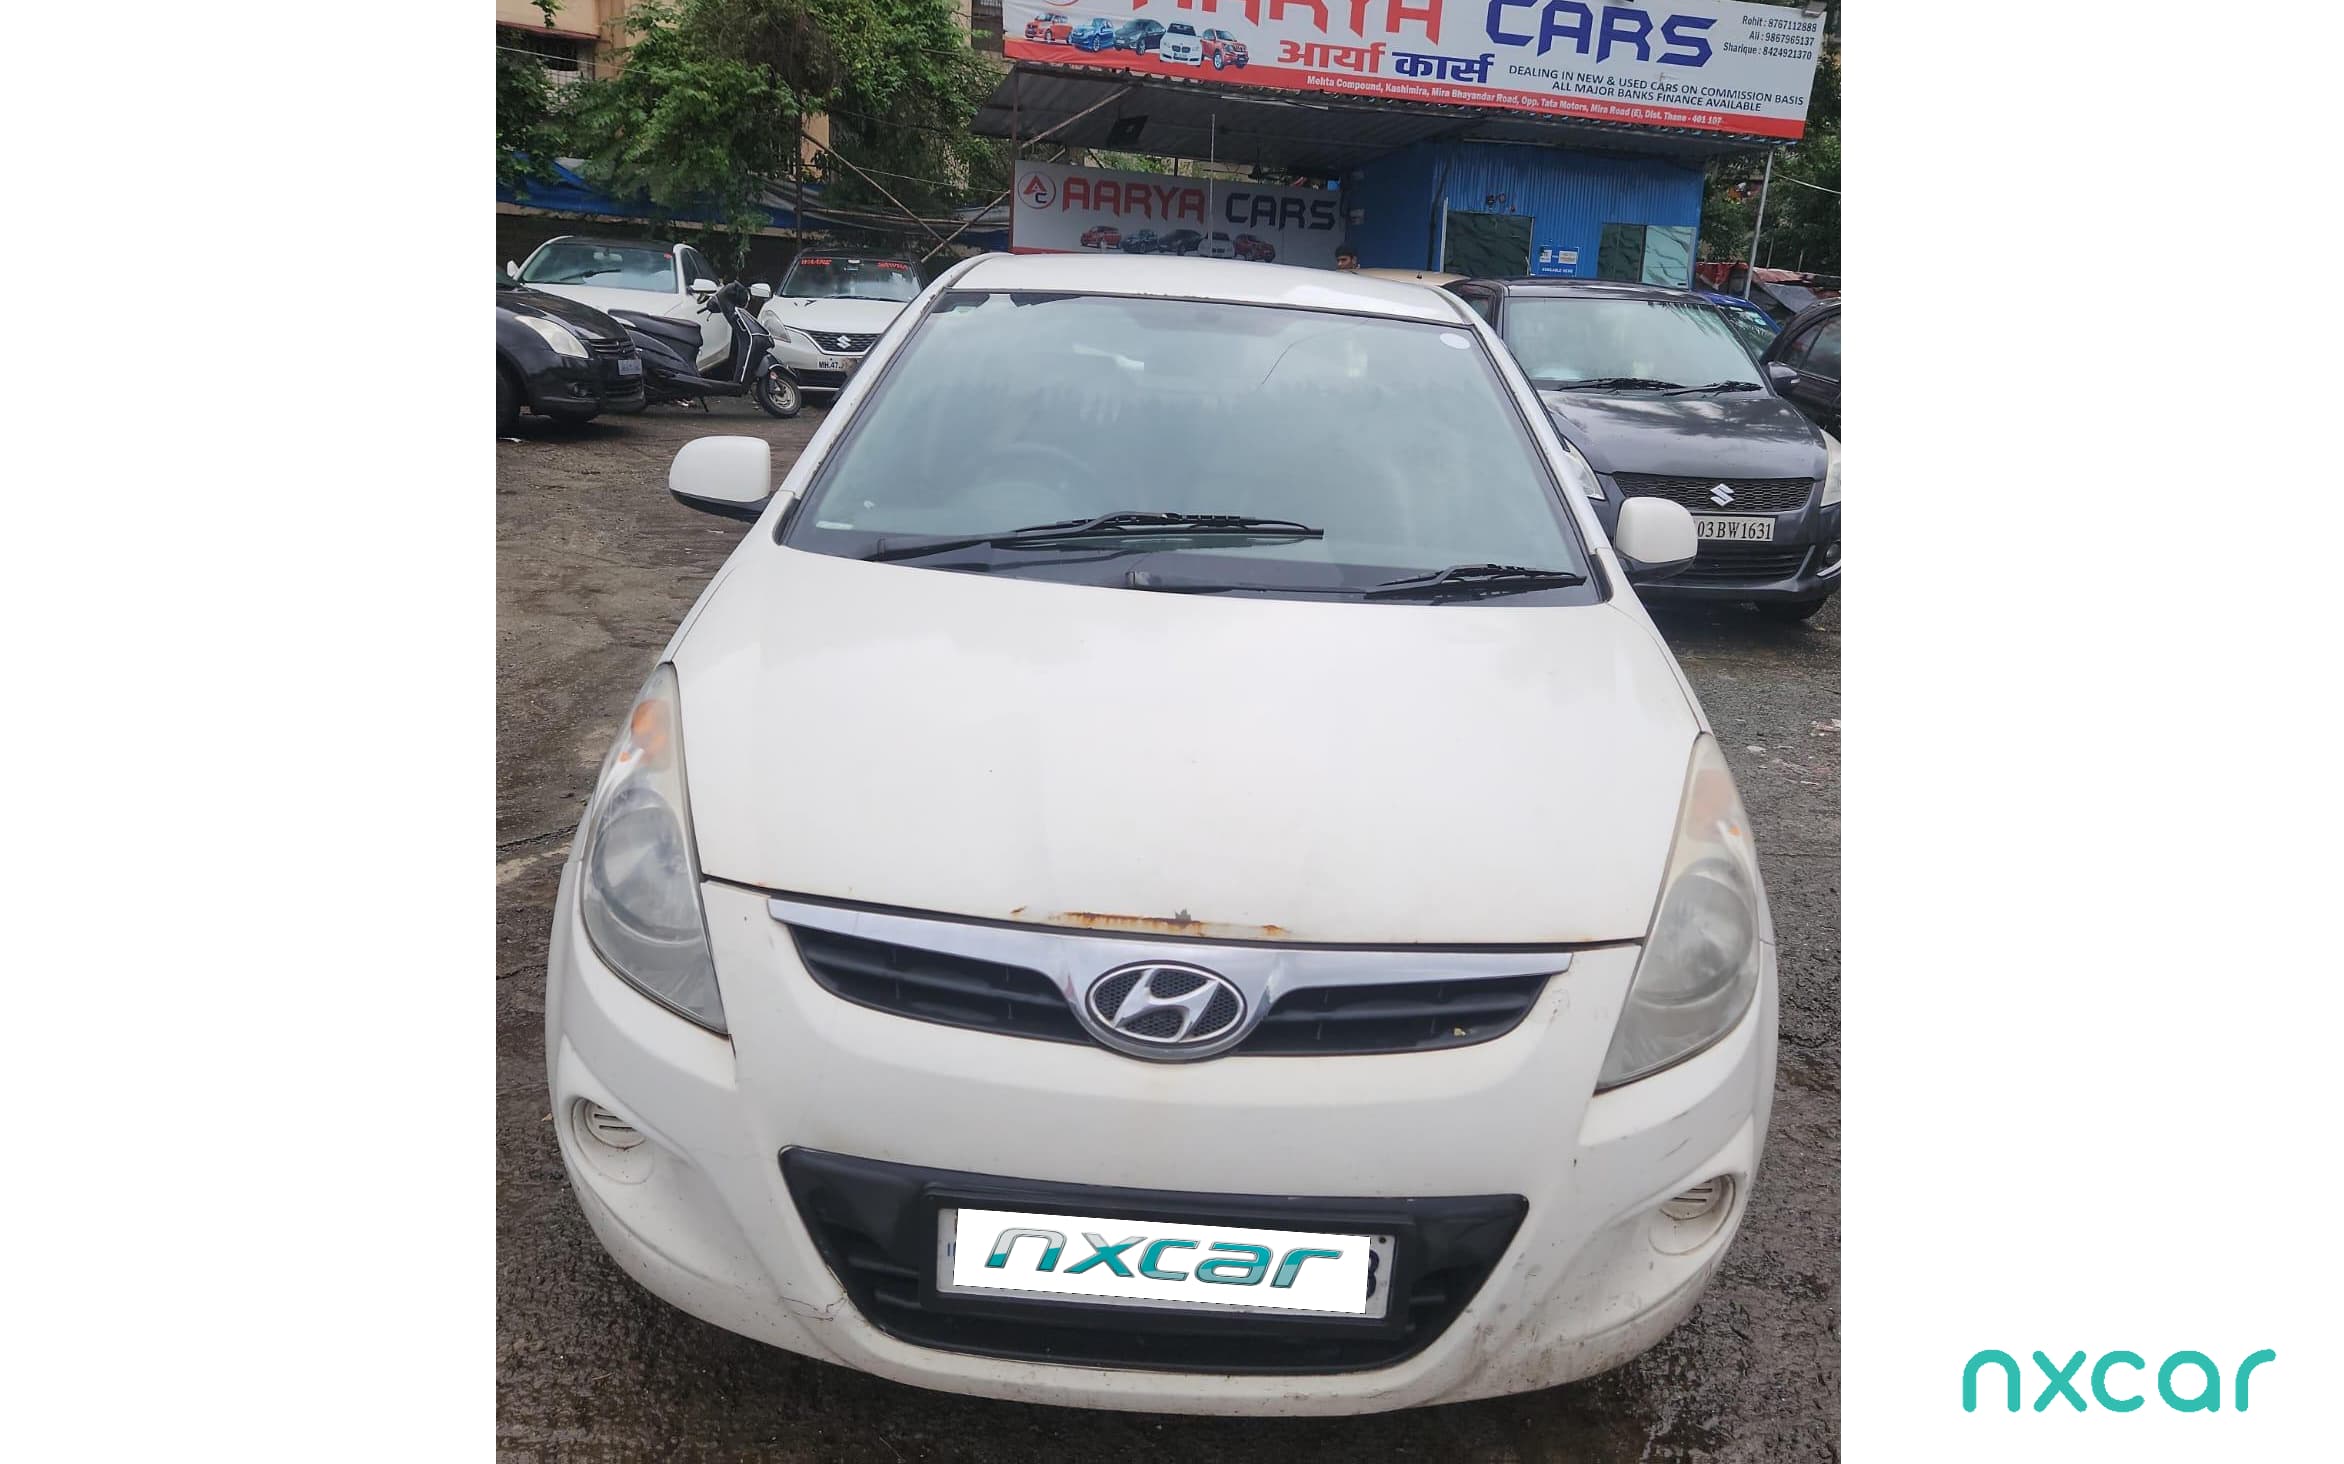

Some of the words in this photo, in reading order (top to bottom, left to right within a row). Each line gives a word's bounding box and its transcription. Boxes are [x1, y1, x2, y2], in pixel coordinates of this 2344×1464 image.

[1486, 0, 1718, 67] CARS
[1742, 15, 1763, 27] Rohit
[1278, 39, 1387, 73] आर्या
[1391, 51, 1495, 84] कार्स
[1723, 42, 1758, 57] Sharique
[1307, 75, 1335, 87] Mehta
[1336, 78, 1384, 93] Compound,
[1431, 86, 1450, 98] Mira
[1451, 88, 1495, 102] Bhayandar
[1521, 96, 1539, 109] Opp.
[1540, 98, 1558, 109] Tata
[1590, 103, 1609, 114] Mira
[1609, 105, 1630, 117] Road
[1509, 65, 1558, 79] DEALING
[1561, 71, 1574, 81] IN
[1576, 72, 1604, 84] NEW
[1606, 76, 1615, 86] &
[1619, 78, 1648, 89] USED
[1650, 81, 1678, 93] CARS
[1681, 84, 1698, 95] ON
[1700, 86, 1773, 102] COMMISSION
[1775, 94, 1804, 106] BASIS
[1552, 81, 1572, 92] ALL
[1574, 83, 1614, 97] MAJOR
[1617, 88, 1654, 101] BANKS
[1656, 92, 1705, 106] FINANCE
[1705, 98, 1762, 112] AVAILABLE
[1062, 176, 1205, 224] AARYA
[1225, 192, 1336, 231] CARS
